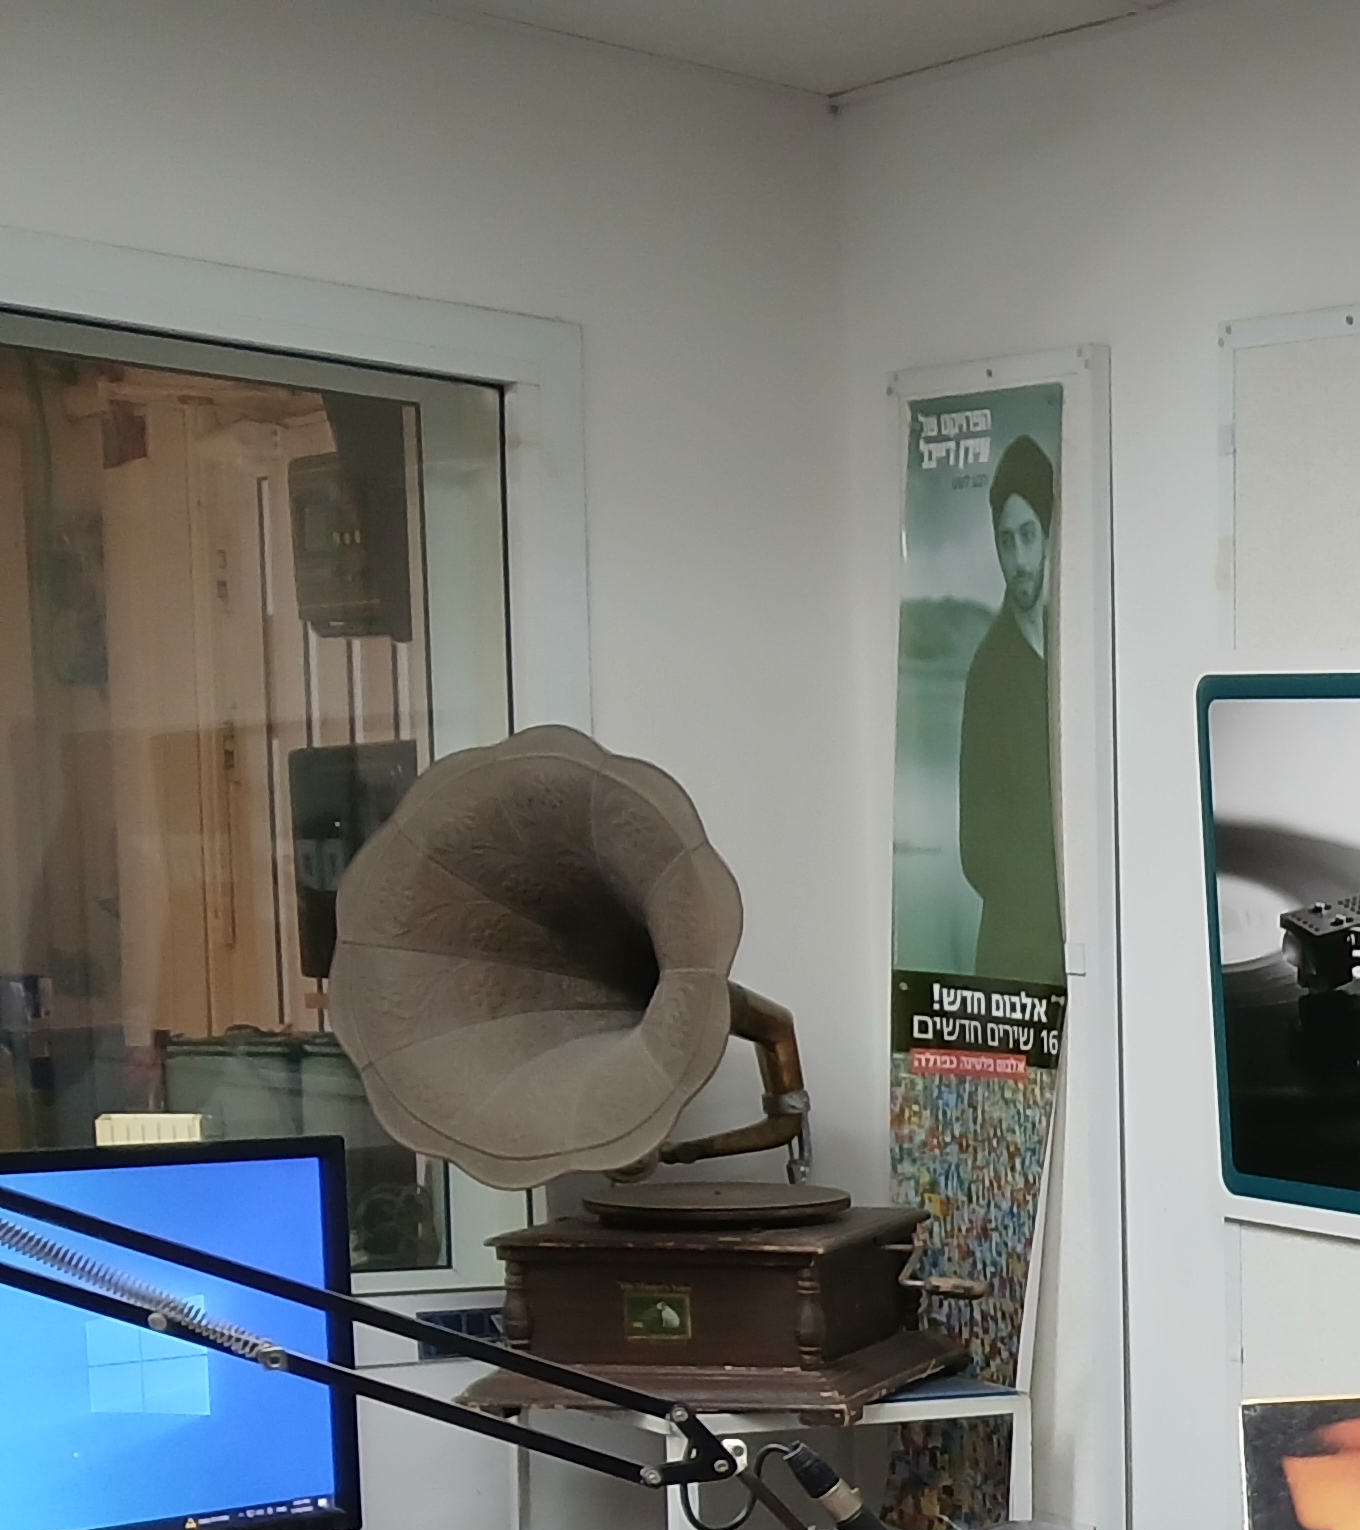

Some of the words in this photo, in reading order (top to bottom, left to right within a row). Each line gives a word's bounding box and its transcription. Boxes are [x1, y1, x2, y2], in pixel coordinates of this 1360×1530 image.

[932, 983, 986, 1016] חדש!
[991, 991, 1048, 1023] אלבום
[912, 1015, 982, 1044] חדשים
[986, 1023, 1034, 1051] שירים
[1040, 1029, 1059, 1055] 16
